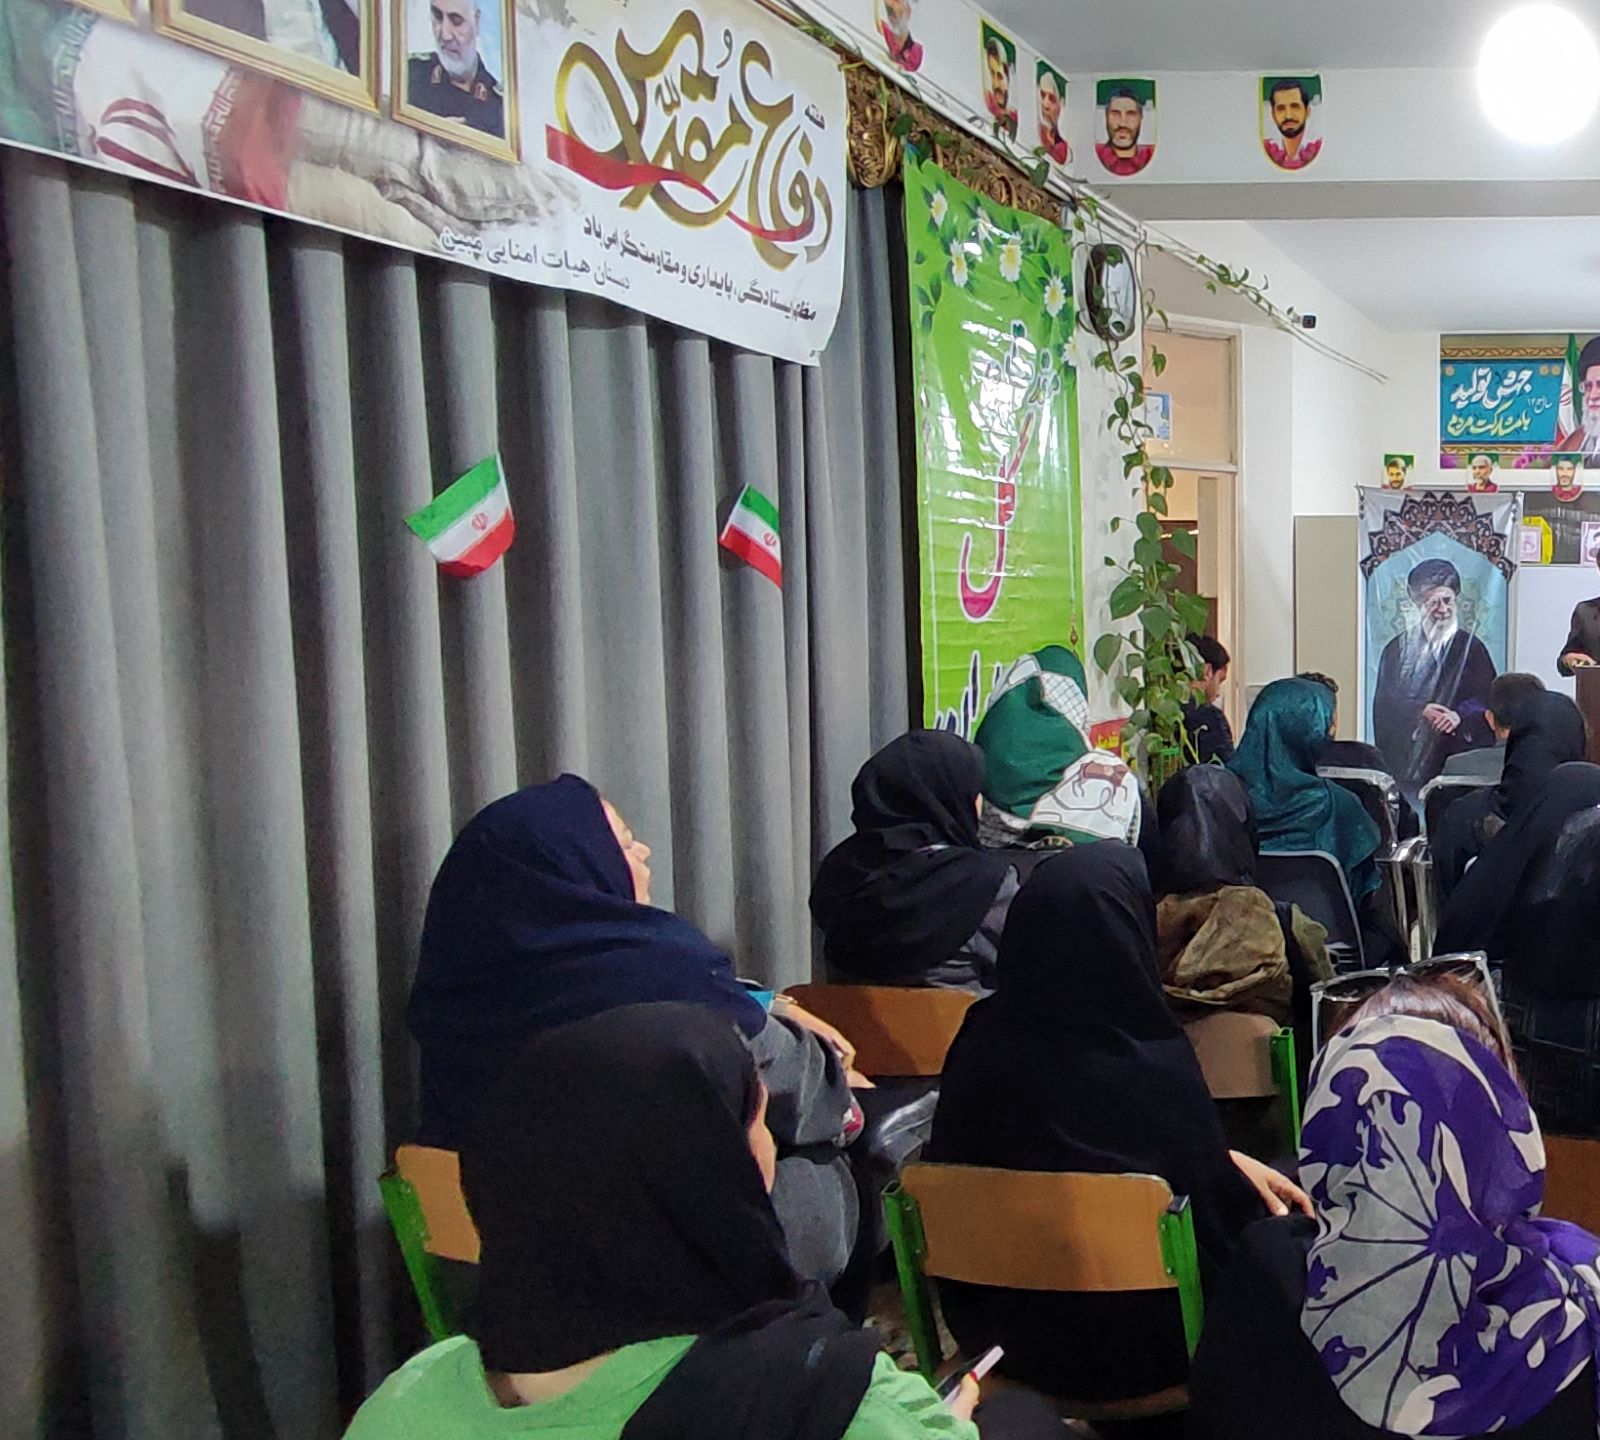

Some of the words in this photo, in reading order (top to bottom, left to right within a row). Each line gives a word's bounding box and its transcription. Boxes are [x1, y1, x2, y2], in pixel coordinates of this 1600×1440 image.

[740, 40, 834, 272] دفاع
[583, 214, 603, 248] باد
[486, 238, 538, 264] امنایی
[541, 250, 591, 278] هیات
[639, 242, 680, 275] مقاومت
[679, 264, 687, 284] و
[688, 264, 733, 301] پایداری
[1449, 366, 1493, 410] تولید
[1482, 369, 1533, 410] جهش
[1447, 414, 1474, 437] مردم
[1470, 397, 1523, 437] مشارکت
[1521, 410, 1532, 432] با
